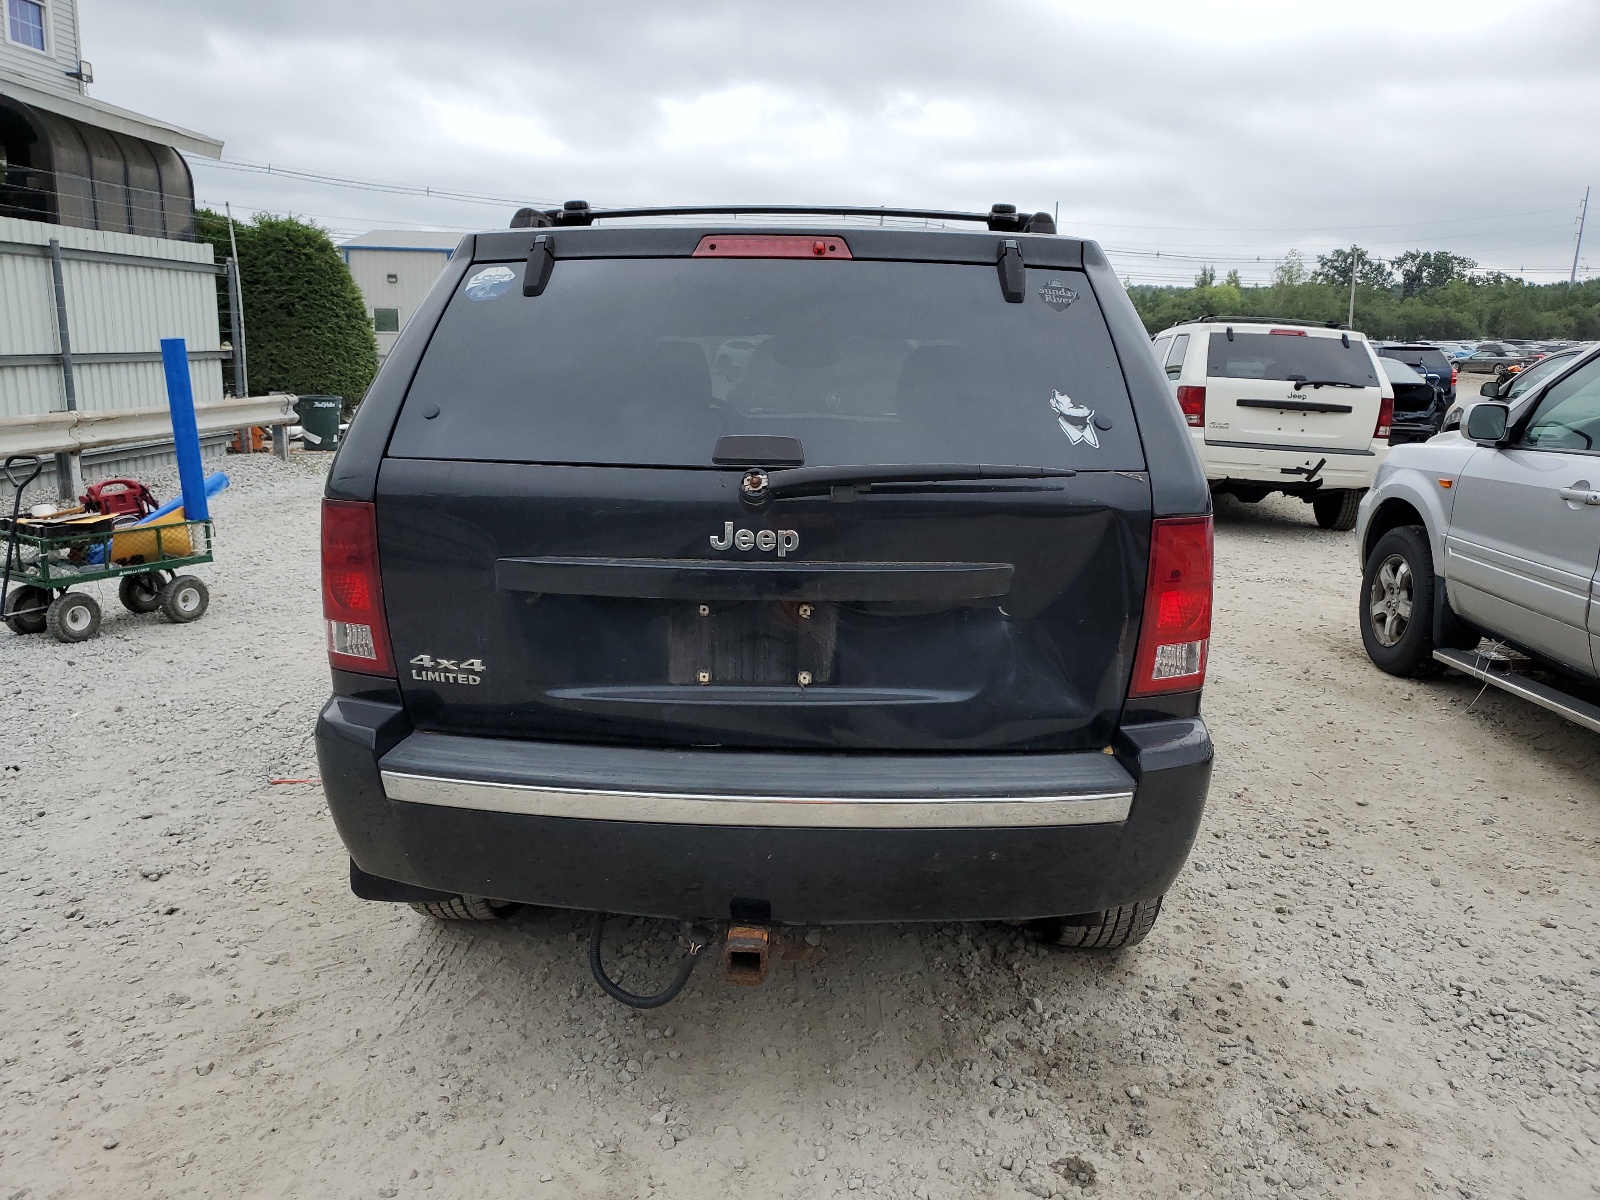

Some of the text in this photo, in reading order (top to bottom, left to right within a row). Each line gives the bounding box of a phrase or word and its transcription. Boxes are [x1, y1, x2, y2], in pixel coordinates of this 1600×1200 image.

[1039, 287, 1077, 299] Sunday
[1045, 295, 1073, 304] River
[1287, 392, 1307, 400] Jeep
[709, 521, 800, 557] Jeep
[409, 654, 487, 672] 4x4
[411, 669, 482, 685] LIMITED
